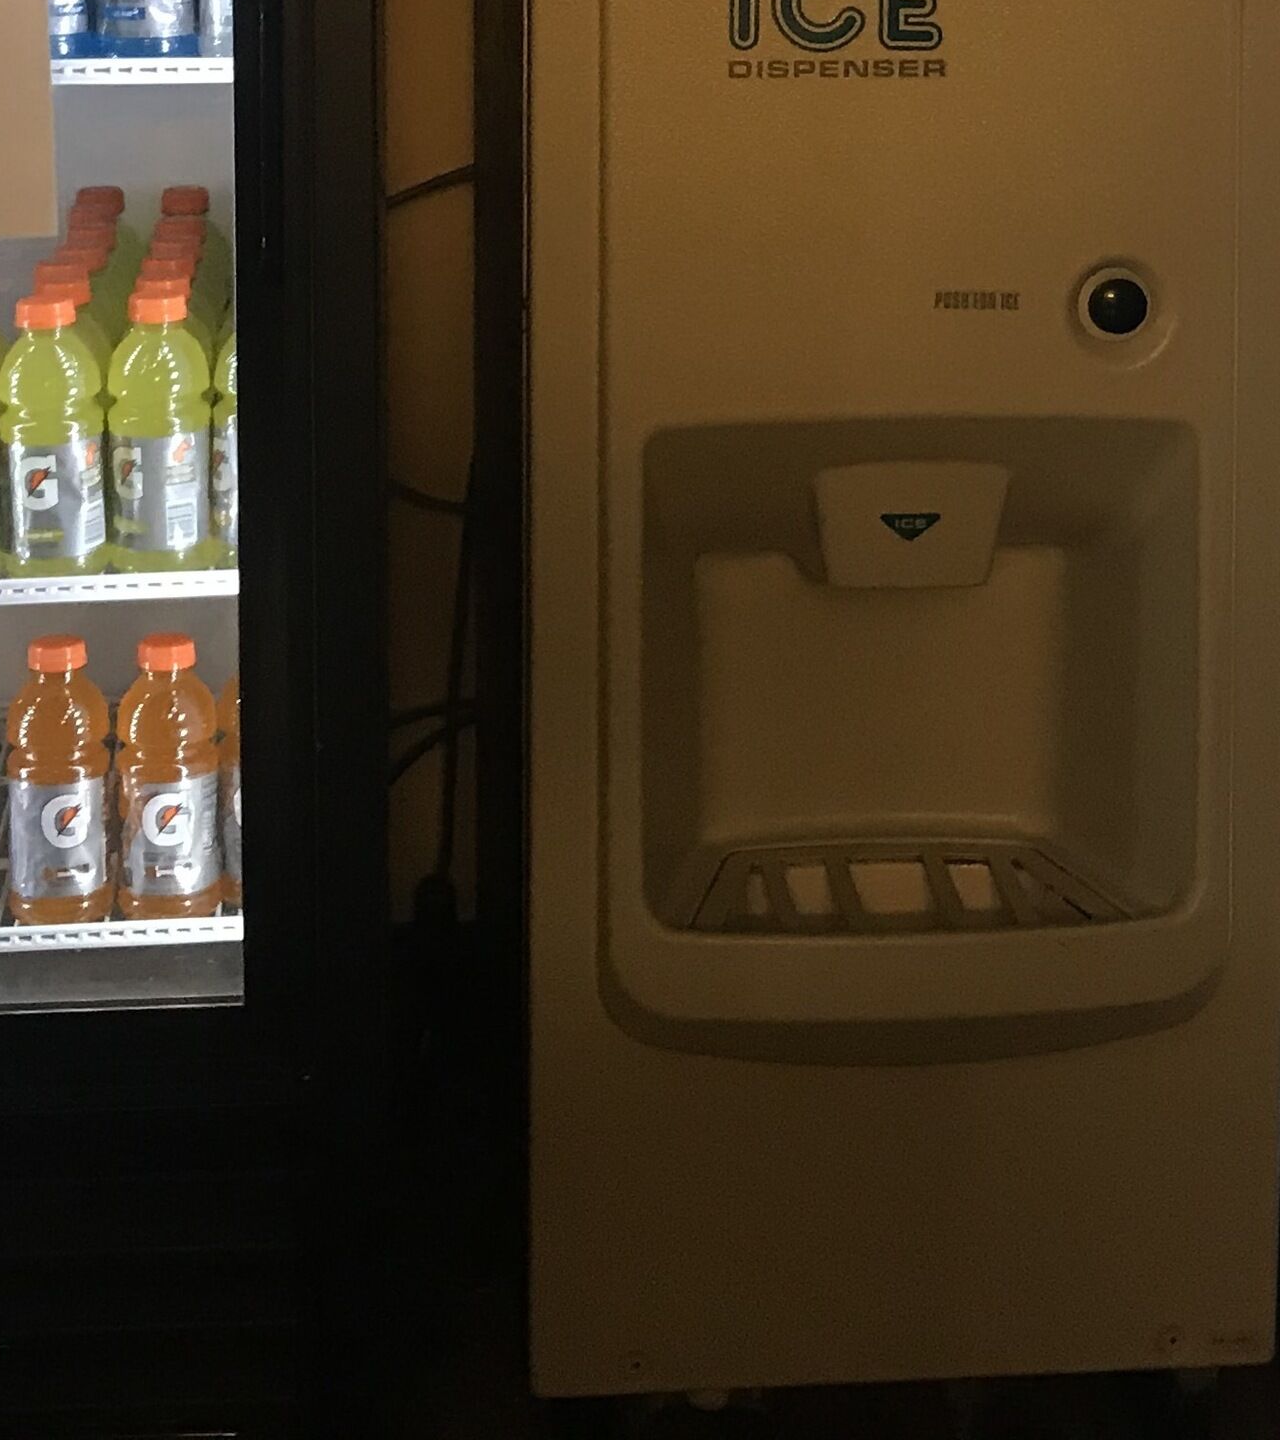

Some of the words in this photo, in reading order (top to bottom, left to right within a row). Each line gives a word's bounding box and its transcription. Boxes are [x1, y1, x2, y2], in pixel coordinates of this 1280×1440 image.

[727, 59, 947, 80] DISPENSER
[21, 455, 59, 510] G
[41, 791, 91, 848] G
[142, 792, 192, 847] G
